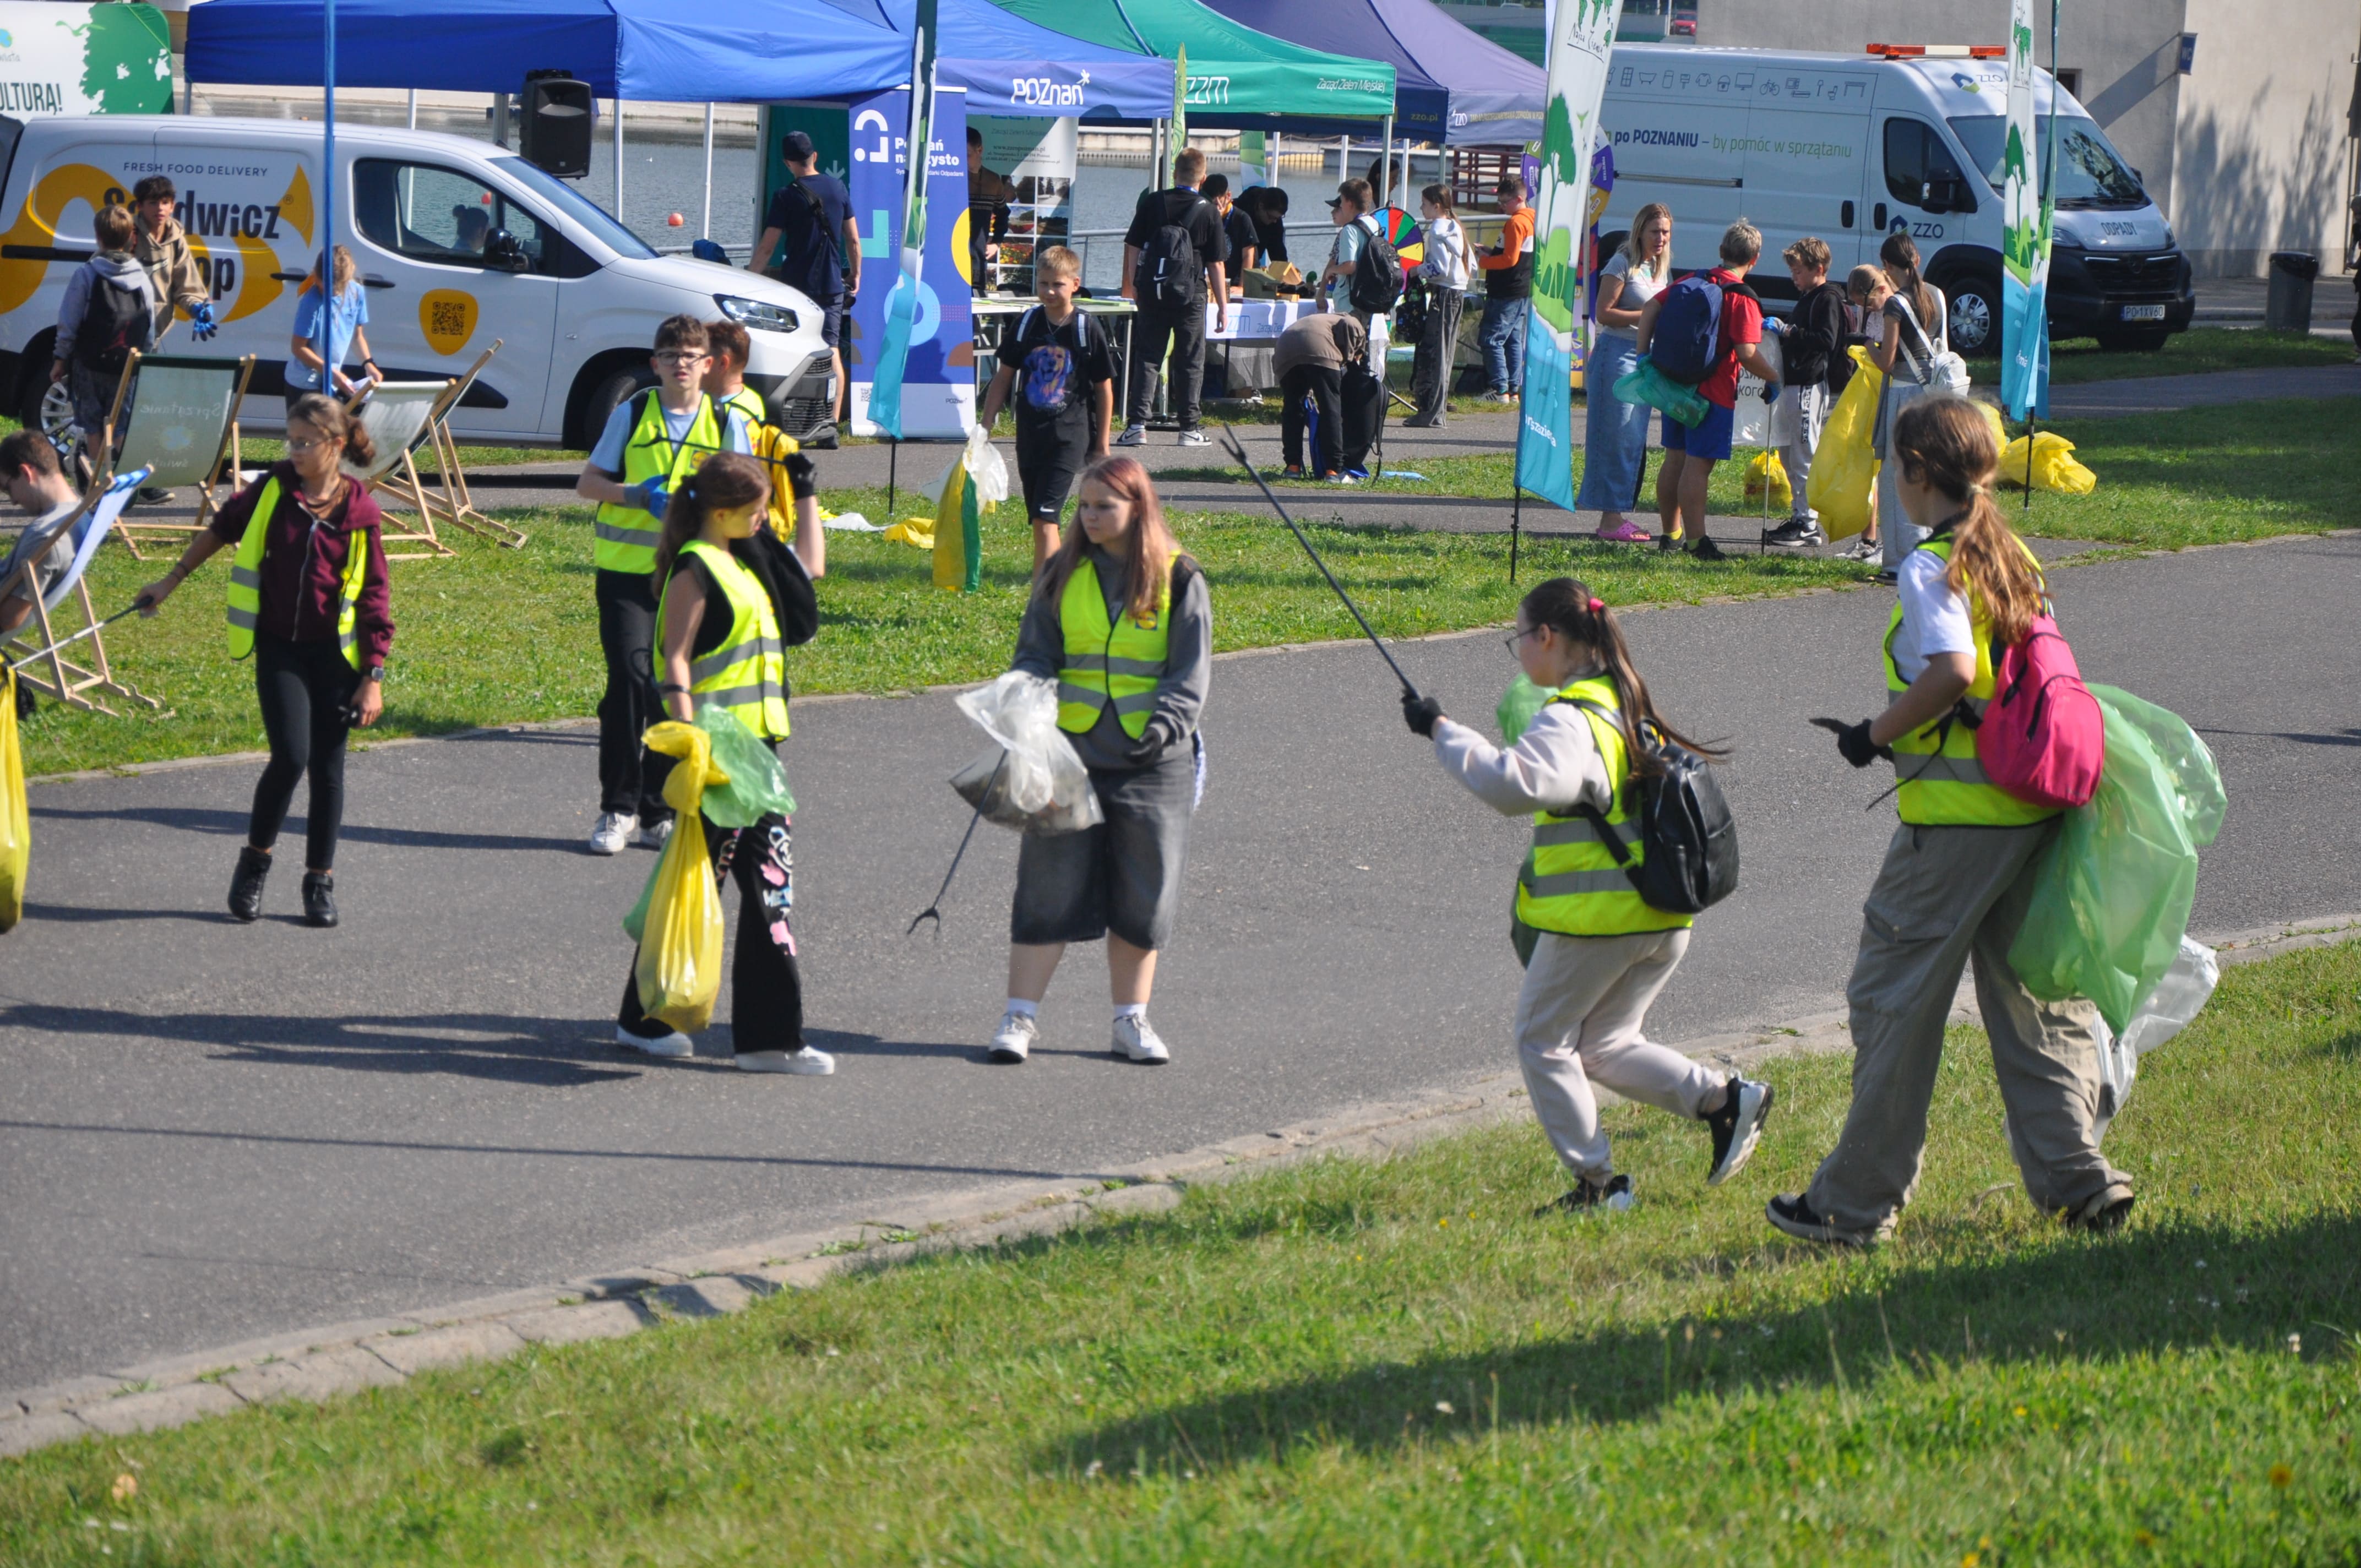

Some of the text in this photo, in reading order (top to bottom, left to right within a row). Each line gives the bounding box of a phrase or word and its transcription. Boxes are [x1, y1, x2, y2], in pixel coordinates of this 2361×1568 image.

[895, 137, 944, 151] Pań
[1614, 130, 1630, 145] po
[1633, 129, 1699, 148] POZNANIU
[1713, 134, 1726, 152] by
[1730, 136, 1770, 154] pomóc
[1775, 141, 1785, 152] w
[1788, 140, 1852, 159] sprzątaniu
[928, 154, 960, 167] zysto
[124, 162, 268, 177] FRESH FOOD DELIVERY
[104, 187, 281, 239] dwicz
[1913, 222, 1944, 239] ZZO
[2101, 222, 2137, 236] ODPADY
[195, 257, 235, 301] op
